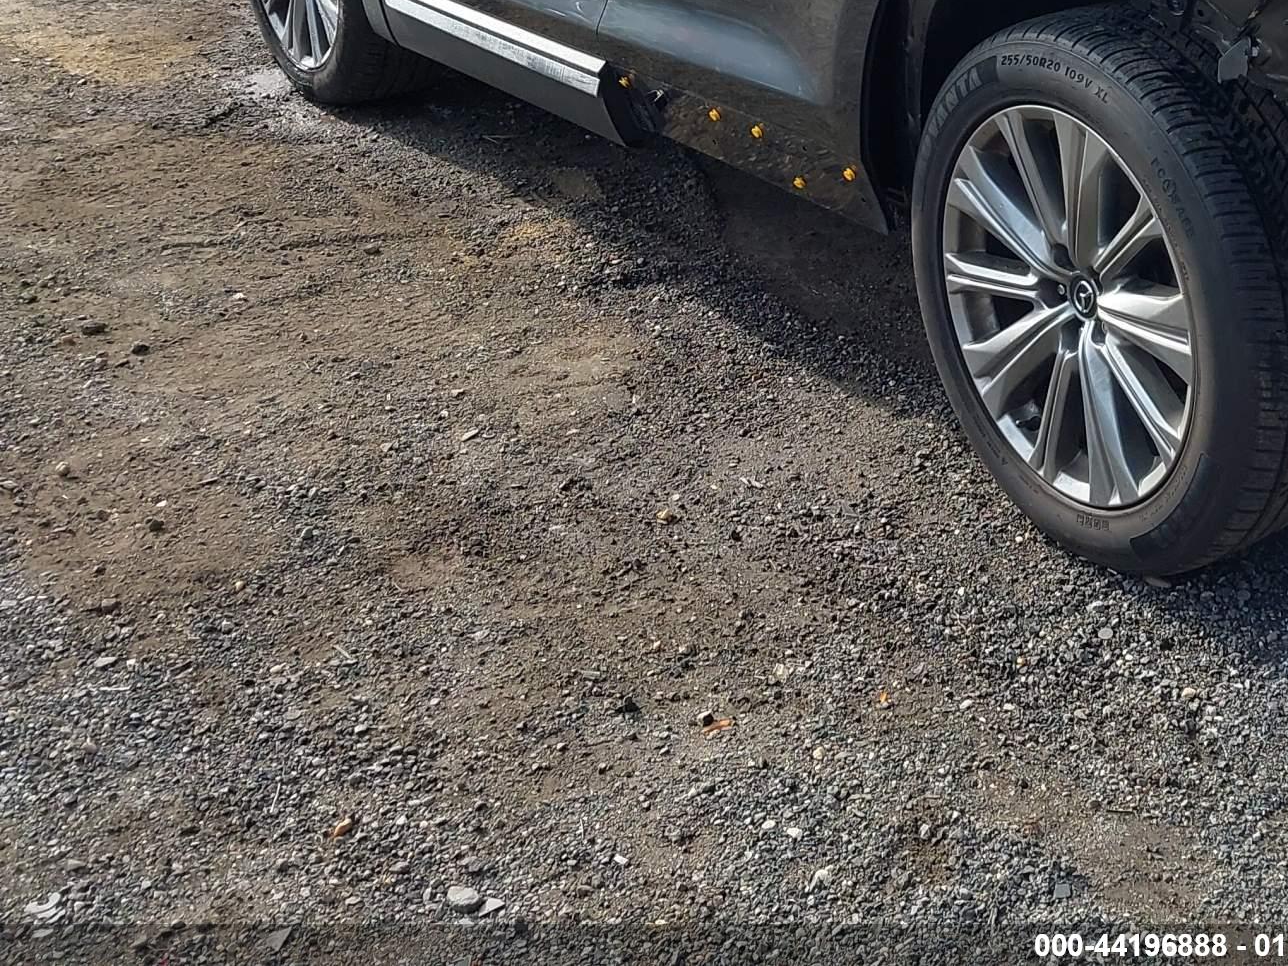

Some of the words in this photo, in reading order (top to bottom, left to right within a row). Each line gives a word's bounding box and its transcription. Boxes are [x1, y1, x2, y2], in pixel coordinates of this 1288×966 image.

[1000, 53, 1061, 73] 255/50R20
[1064, 65, 1093, 89] 109V
[1094, 86, 1109, 104] XL
